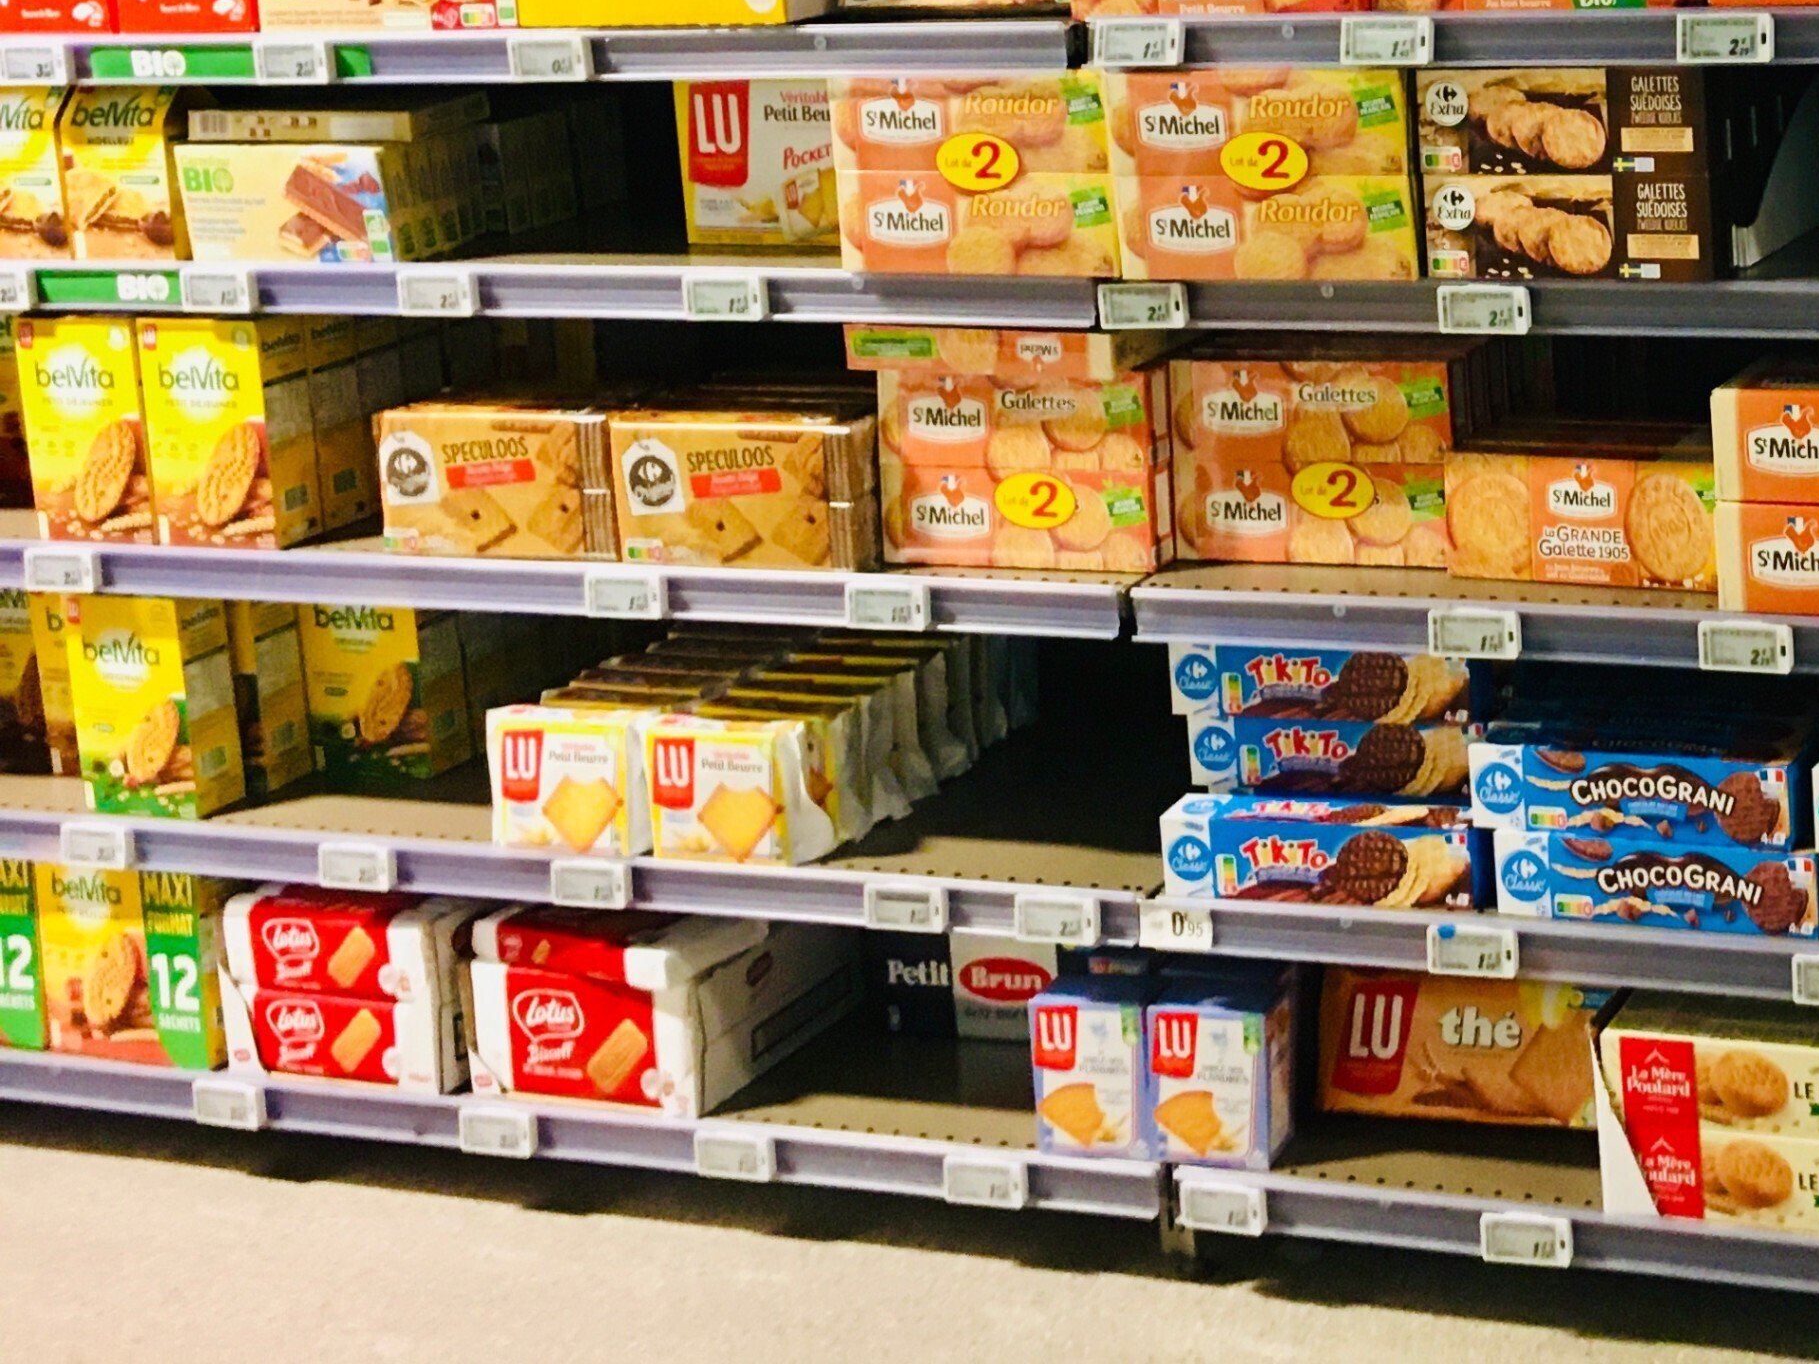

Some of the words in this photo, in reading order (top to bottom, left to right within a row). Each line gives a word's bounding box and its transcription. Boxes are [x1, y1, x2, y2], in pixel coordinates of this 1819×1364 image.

[131, 51, 186, 77] BIO
[1631, 77, 1680, 93] GALETTES
[71, 93, 155, 129] belVita
[964, 93, 1059, 116] Roudor
[1250, 97, 1350, 121] Roudor
[1429, 103, 1467, 117] Extra
[694, 93, 740, 154] LU
[879, 109, 936, 130] Michel
[971, 141, 1001, 179] 2
[1637, 183, 1686, 201] GALETTES
[970, 194, 1065, 218] Roudor
[1260, 200, 1360, 224] Roudor
[1437, 206, 1473, 224] Extra
[117, 275, 169, 301] BIO
[35, 351, 114, 390] belVita
[159, 353, 239, 392] belVita
[442, 437, 528, 462] SPECULOOS
[686, 447, 775, 471] SPECULOOS
[1028, 482, 1058, 516] 2
[1326, 470, 1358, 506] 2
[1539, 539, 1596, 559] Galette
[1597, 543, 1629, 560] 1905
[82, 633, 160, 666] belVita
[1571, 774, 1735, 816] CHOCOGRANI
[1598, 864, 1762, 904] CHOCOGRANI
[272, 927, 311, 951] Lotus
[151, 955, 199, 1011] 12
[887, 958, 949, 988] Petit
[971, 970, 1043, 992] Brun
[277, 1008, 318, 1034] Lotus
[526, 995, 576, 1027] Lotus
[1350, 993, 1403, 1061] LU
[1439, 1006, 1522, 1050] thé
[1627, 1076, 1690, 1096] Poulard
[1794, 1082, 1814, 1100] LE
